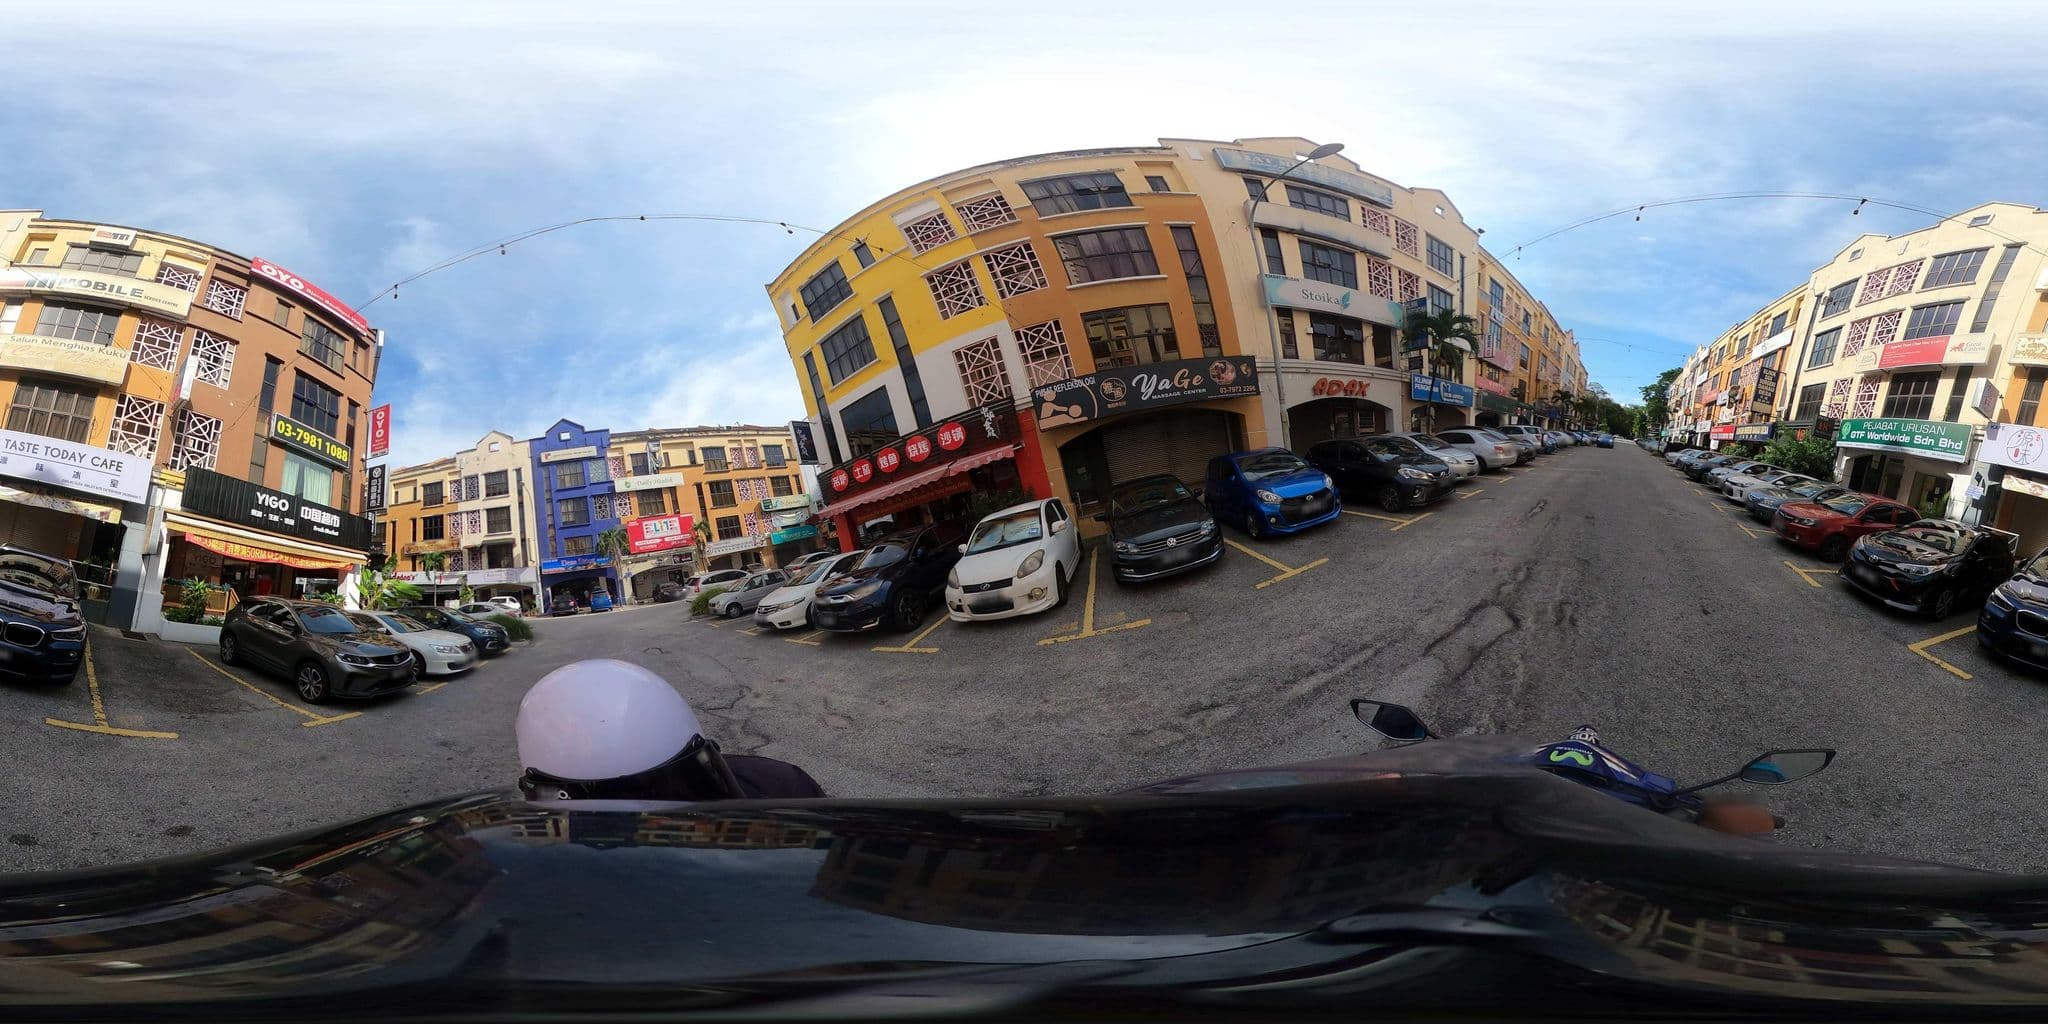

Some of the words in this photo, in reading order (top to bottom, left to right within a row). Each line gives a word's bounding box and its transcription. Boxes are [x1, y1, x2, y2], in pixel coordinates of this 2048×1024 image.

[57, 276, 144, 298] MOBILE
[261, 264, 304, 290] OYO
[1301, 288, 1340, 305] Stoika
[41, 338, 95, 352] Menghias
[98, 346, 126, 359] Kuku
[1131, 368, 1204, 401] YaGe
[1312, 377, 1370, 397] ADAX
[1151, 391, 1181, 400] MASSAGE
[376, 411, 385, 438] OYO
[1863, 421, 1899, 430] PEJABAT
[1901, 422, 1946, 436] URUSAN
[277, 420, 323, 451] 03-7981
[325, 442, 348, 462] 1088
[1850, 430, 1865, 439] GTF
[1867, 431, 1910, 443] Worldwide
[1913, 435, 1935, 446] Sdn
[1938, 438, 1963, 450] Bhd
[5, 438, 40, 454] TASTE
[44, 445, 87, 464] TODAY
[91, 456, 124, 473] CAFE
[256, 491, 290, 512] YIGO
[300, 506, 340, 528] 中国超市
